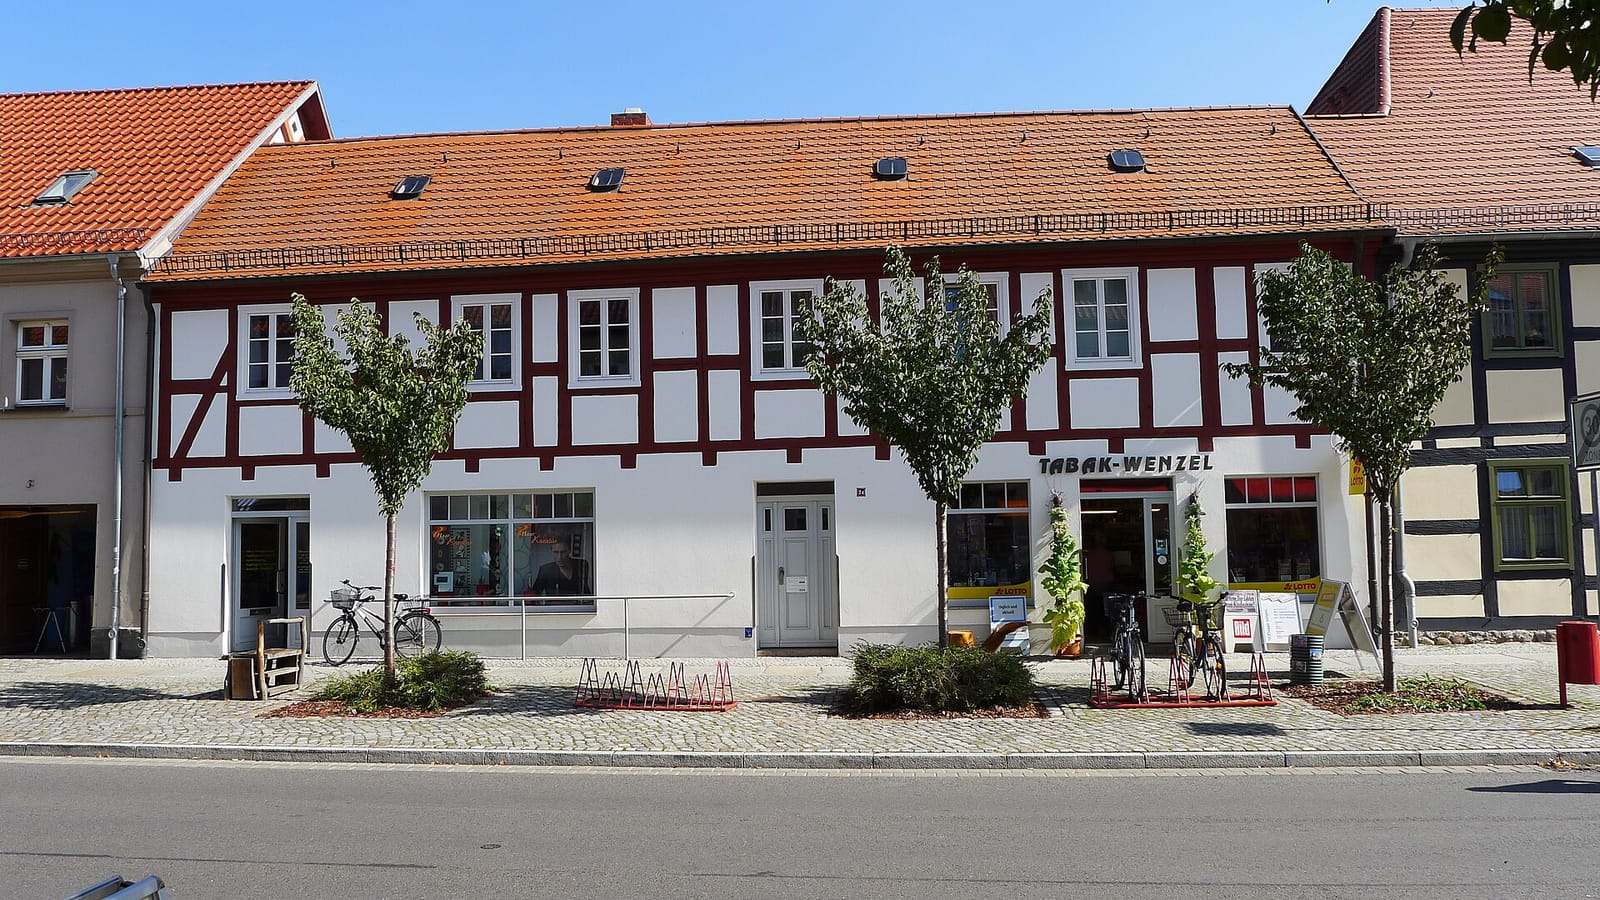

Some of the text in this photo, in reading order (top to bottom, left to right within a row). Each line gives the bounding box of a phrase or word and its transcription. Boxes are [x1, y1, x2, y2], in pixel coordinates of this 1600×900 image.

[1584, 446, 1600, 462] ZON
[1039, 455, 1213, 475] TABAK-WENZEL
[1004, 587, 1027, 595] LOTTO
